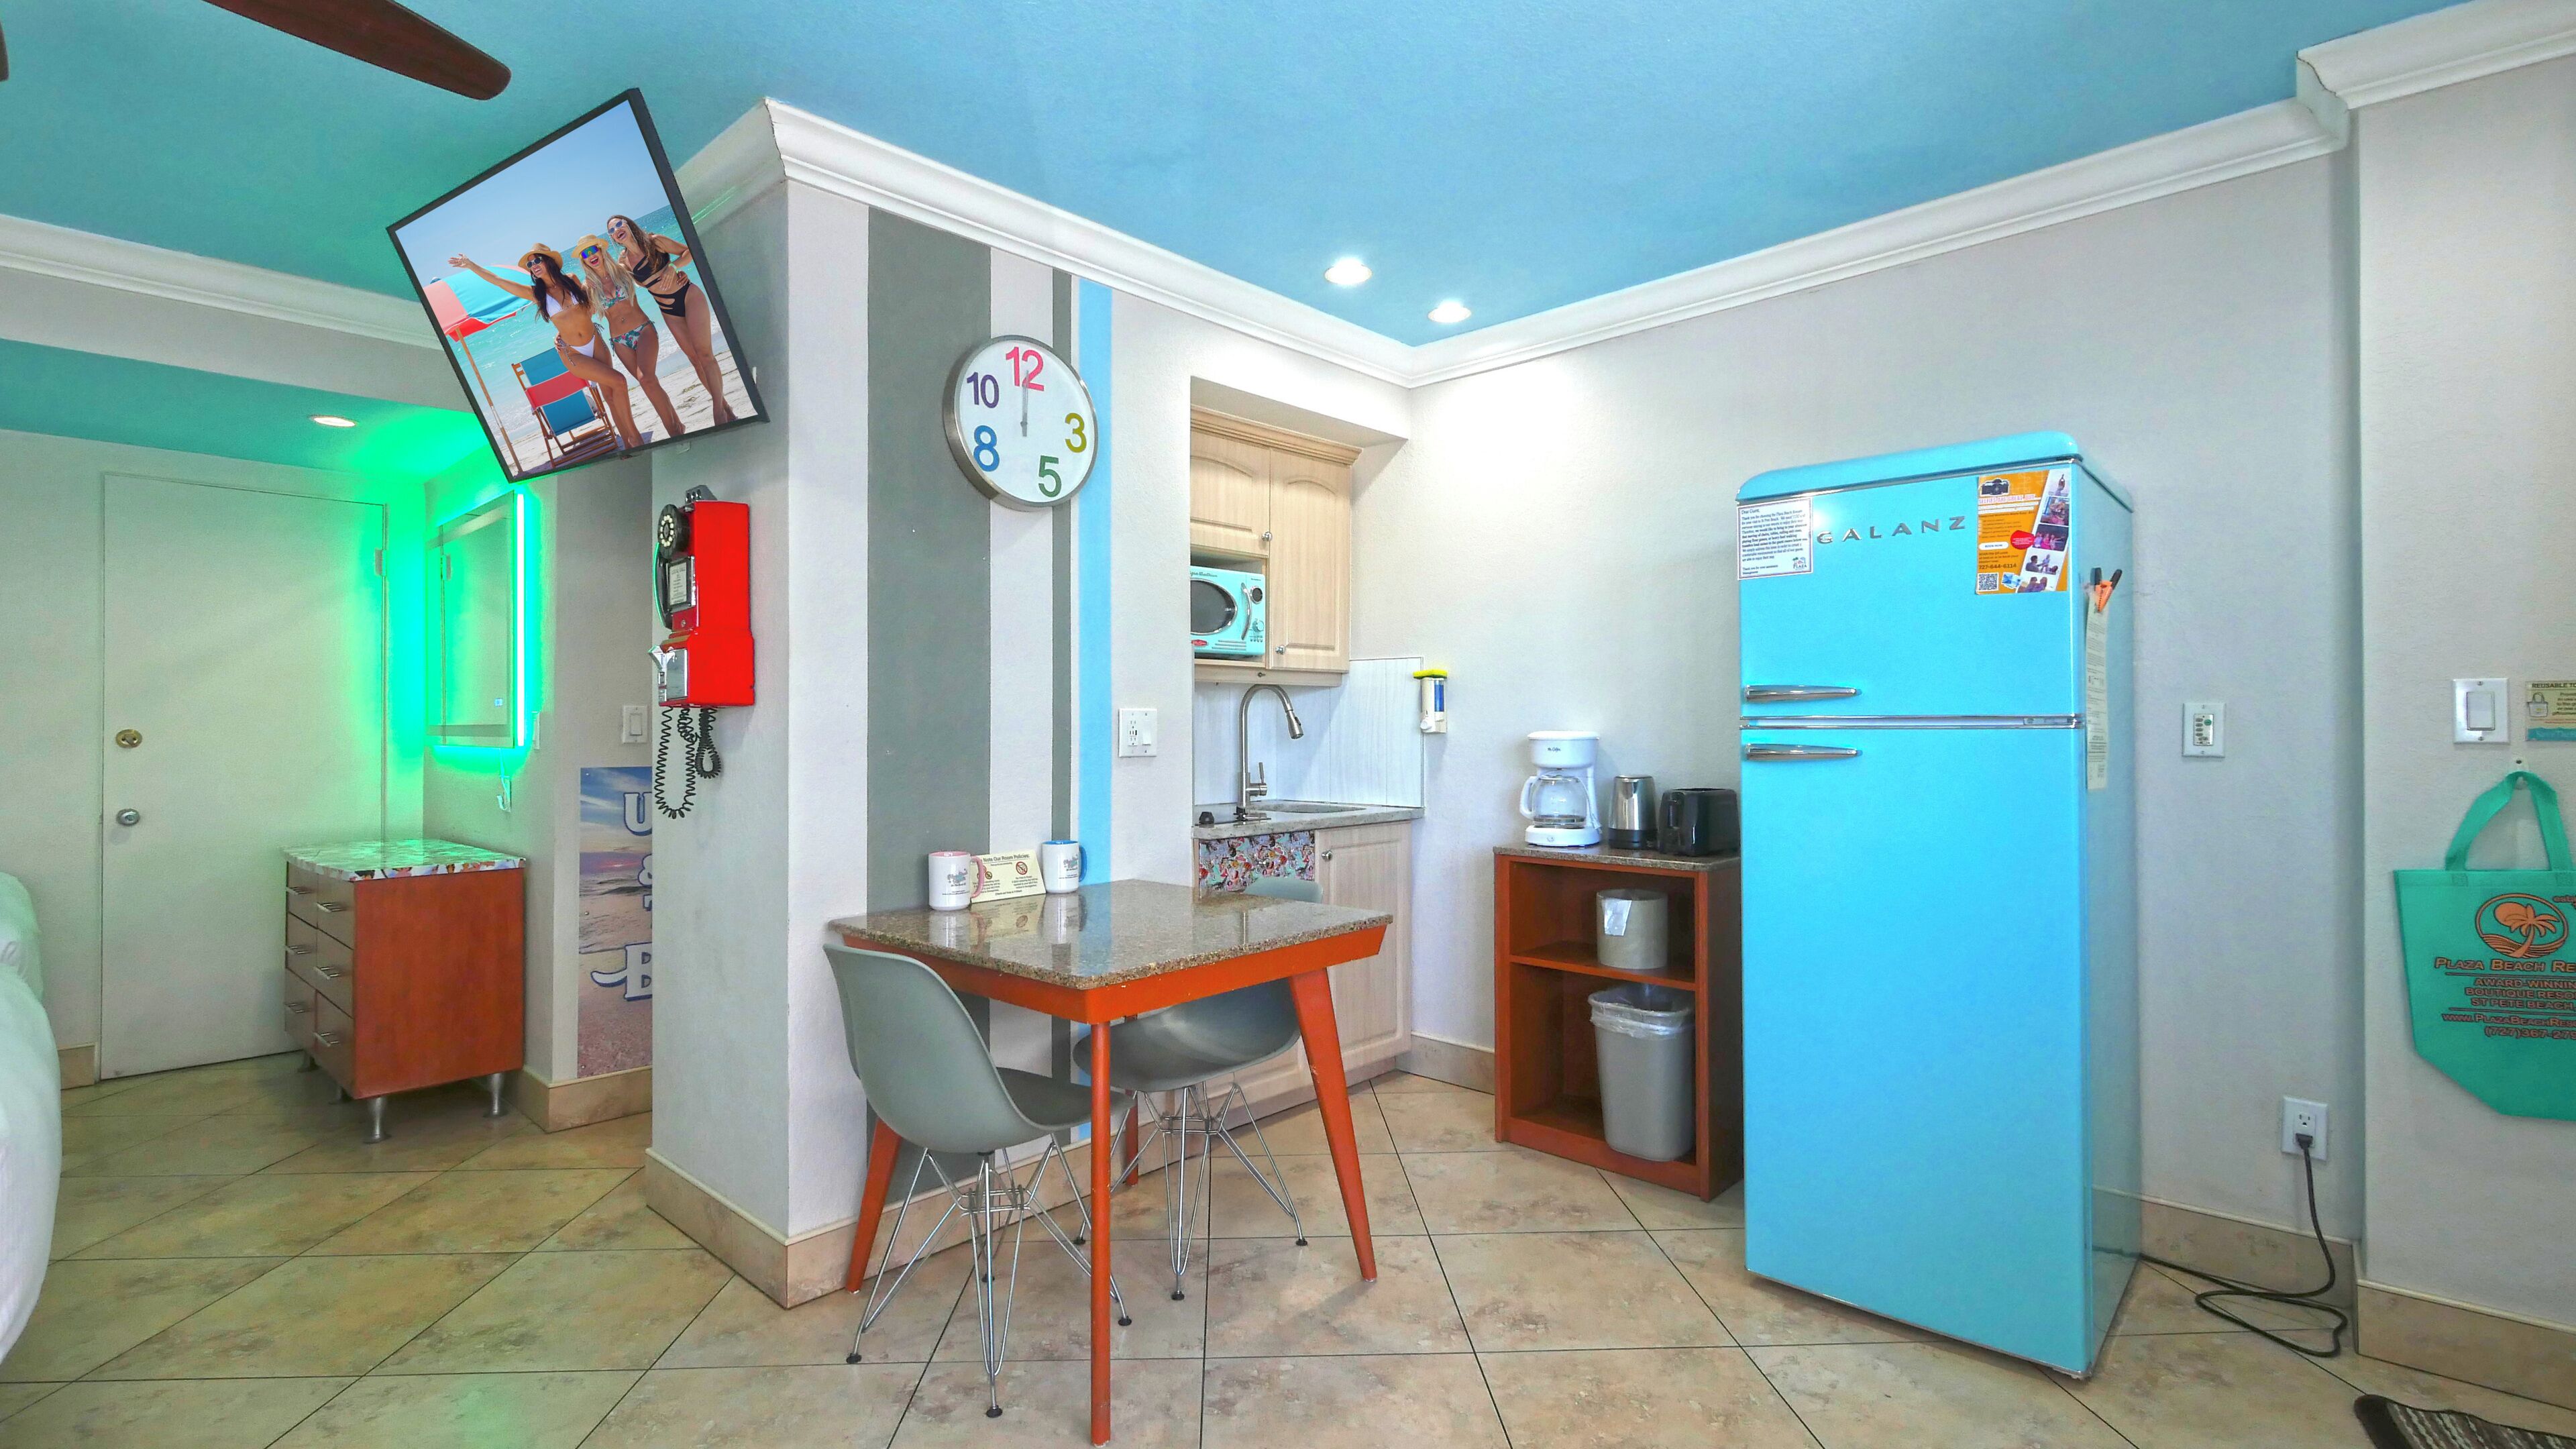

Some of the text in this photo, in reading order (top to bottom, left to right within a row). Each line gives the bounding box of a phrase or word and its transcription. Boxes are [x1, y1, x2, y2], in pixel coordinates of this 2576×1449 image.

[1006, 346, 1044, 392] 12
[967, 372, 1000, 409] 10
[973, 425, 1000, 472] 8
[1065, 413, 1087, 453] 3
[1038, 455, 1062, 498] 5
[1817, 515, 1966, 544] GALANZ
[2434, 957, 2485, 969] PLAZA
[2491, 959, 2546, 971] BEACH
[2465, 987, 2576, 999] BOUTIQUE RESO
[2471, 998, 2488, 1006] ST
[2490, 999, 2524, 1008] PETE
